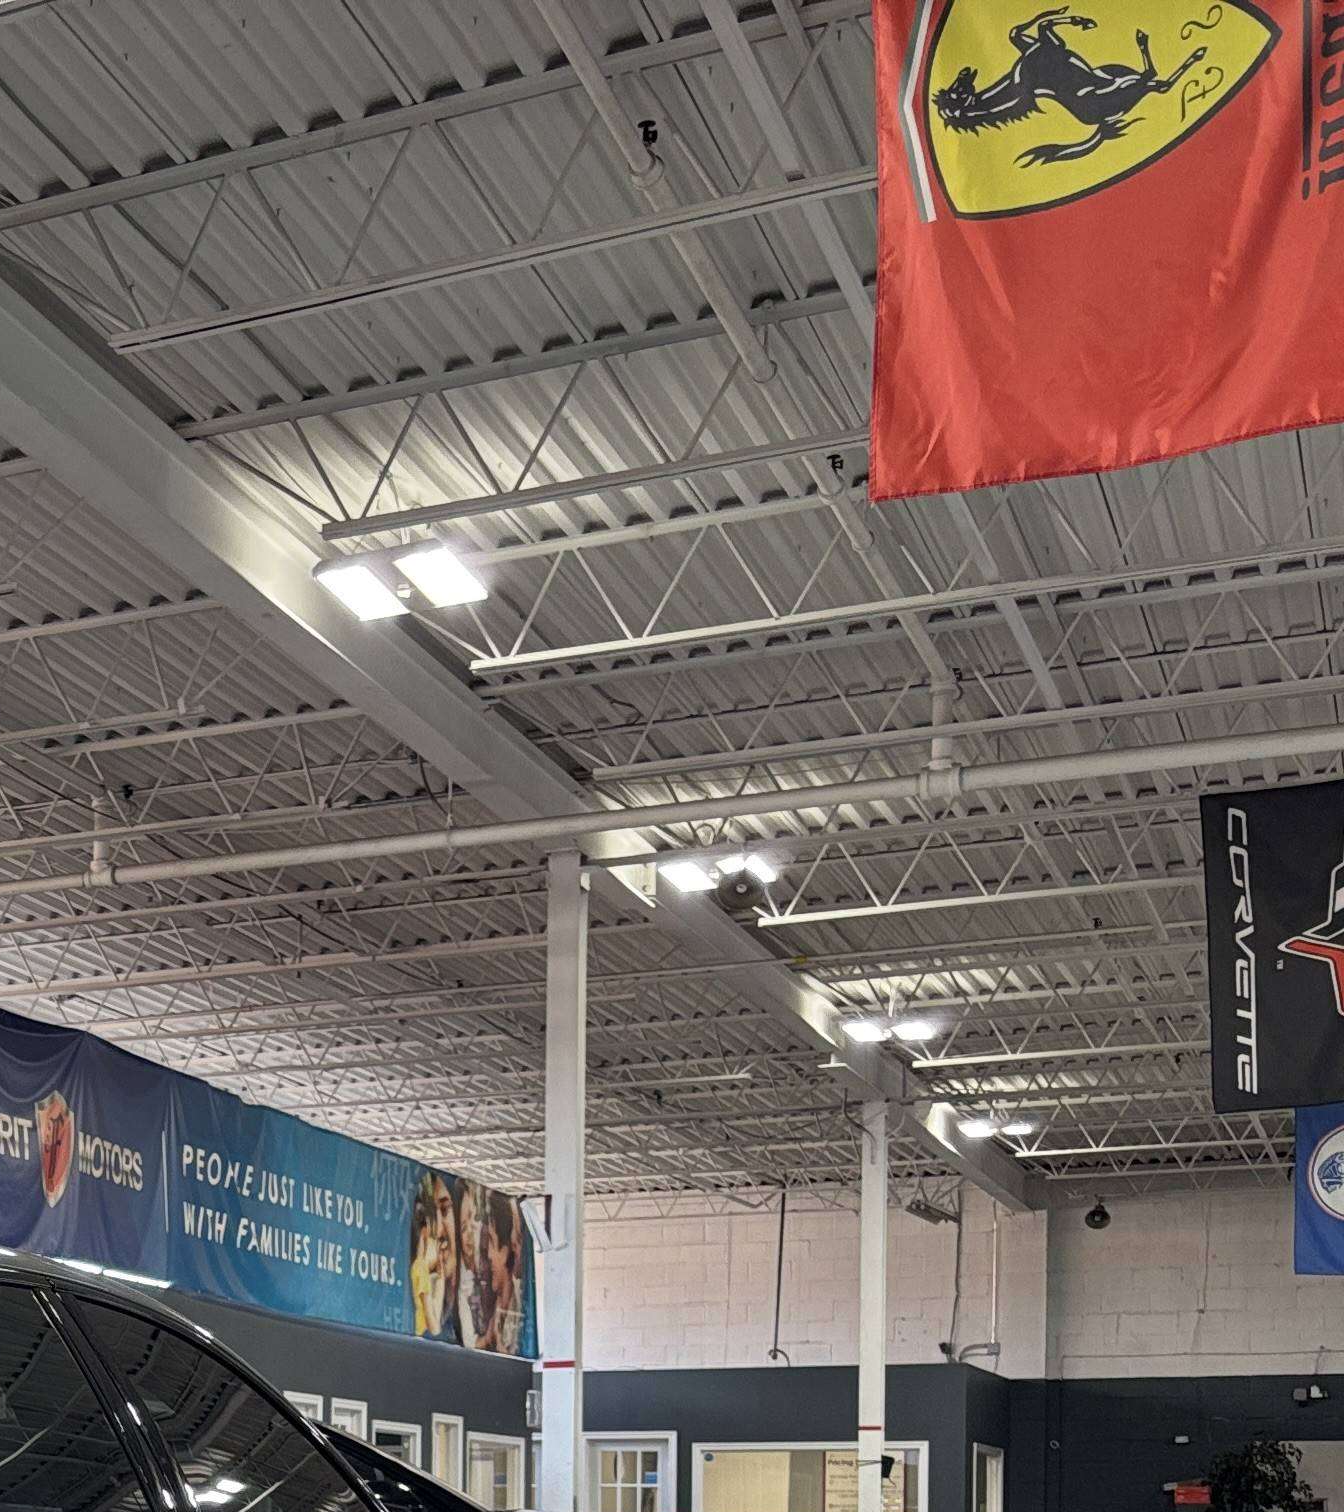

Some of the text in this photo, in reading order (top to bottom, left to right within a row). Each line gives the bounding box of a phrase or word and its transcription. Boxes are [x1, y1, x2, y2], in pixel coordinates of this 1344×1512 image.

[1227, 807, 1258, 1095] CORVETTE
[78, 1130, 144, 1192] MOTORS
[258, 1169, 296, 1209] JUST
[302, 1182, 333, 1220] LIKE
[336, 1193, 369, 1234] YOU,
[182, 1201, 403, 1288] WITH FAMILIES LIKE YOURS.
